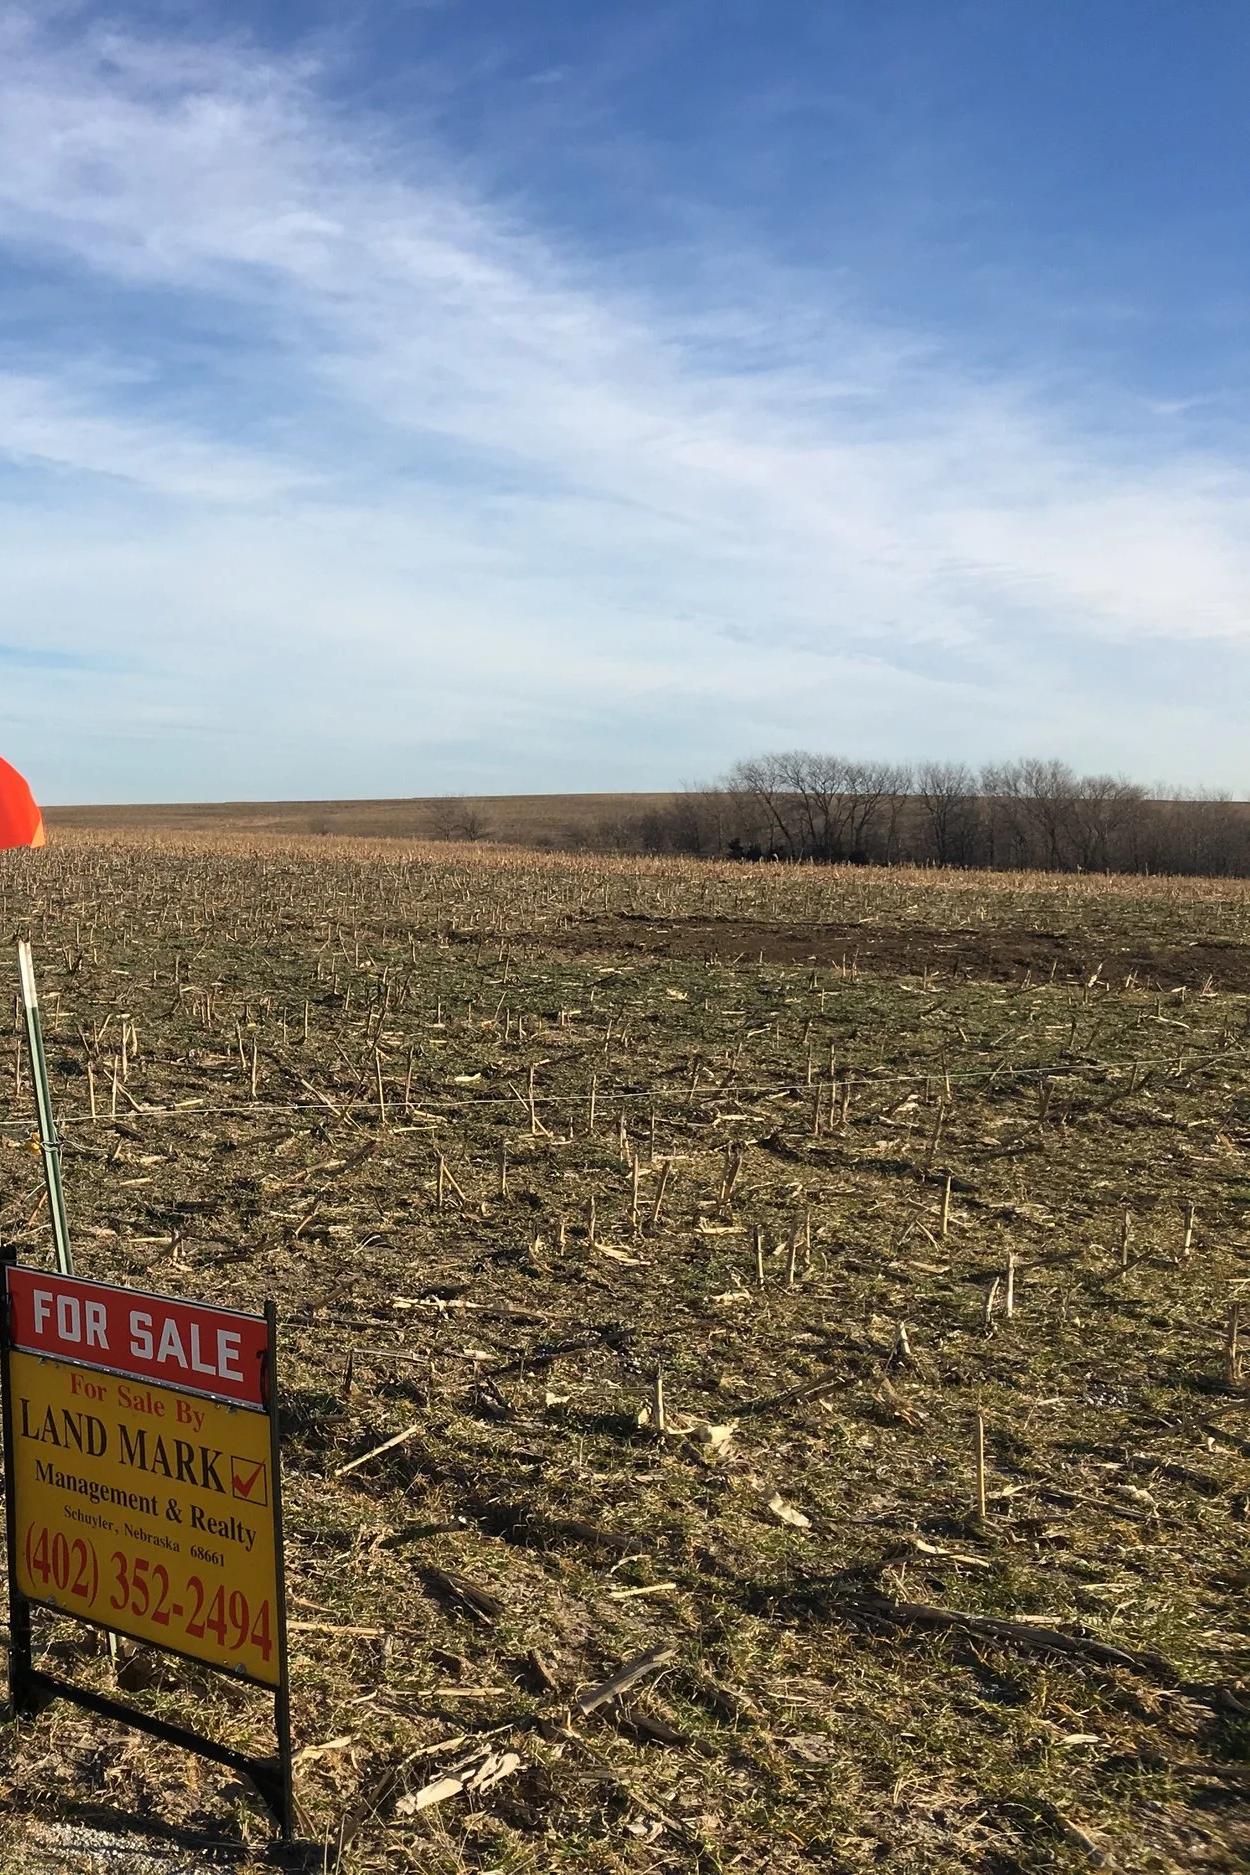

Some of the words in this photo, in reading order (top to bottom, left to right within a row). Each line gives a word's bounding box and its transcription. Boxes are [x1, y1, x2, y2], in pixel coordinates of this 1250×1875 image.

[33, 1289, 109, 1350] FOR
[129, 1310, 244, 1382] SALE
[20, 1398, 108, 1458] LAND
[118, 1424, 226, 1493] MARK
[70, 1372, 107, 1401] For
[117, 1385, 165, 1417] Sale
[176, 1399, 205, 1432] By
[35, 1459, 158, 1516] Management
[165, 1499, 183, 1523] &
[190, 1504, 257, 1552] Realty
[64, 1505, 119, 1535] Schuyler,
[124, 1523, 180, 1552] Nebraska
[189, 1544, 225, 1567] 68661
[25, 1521, 99, 1608] (402)
[109, 1551, 273, 1662] 352-2494
